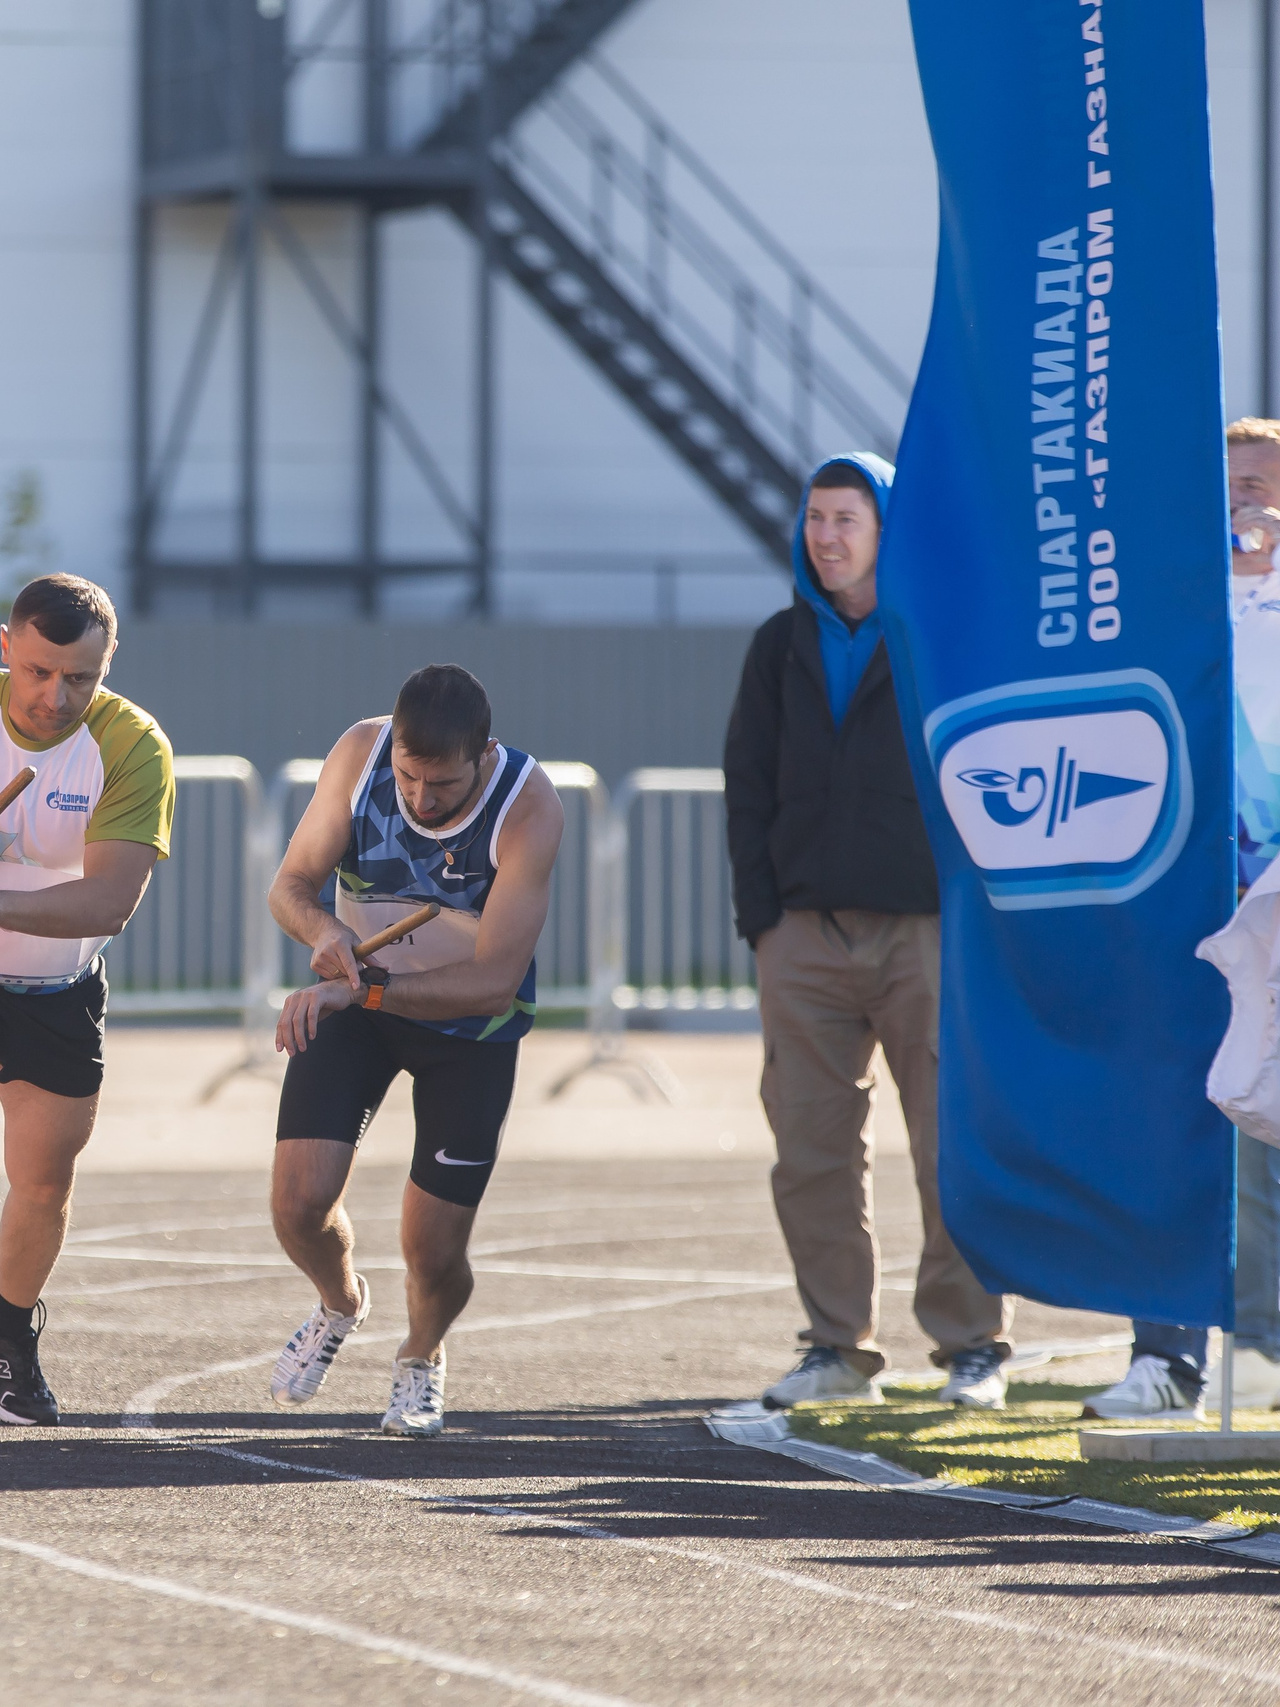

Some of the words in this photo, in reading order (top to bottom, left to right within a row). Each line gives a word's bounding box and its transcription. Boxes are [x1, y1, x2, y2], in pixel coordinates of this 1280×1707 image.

[1079, 0, 1112, 189] ГАЗНА
[1032, 227, 1083, 648] СПАРТАКИАДА
[1085, 208, 1114, 509] «ГАЗПРОМ
[1087, 529, 1122, 642] ООО
[59, 793, 90, 805] ГАЗПРОМ
